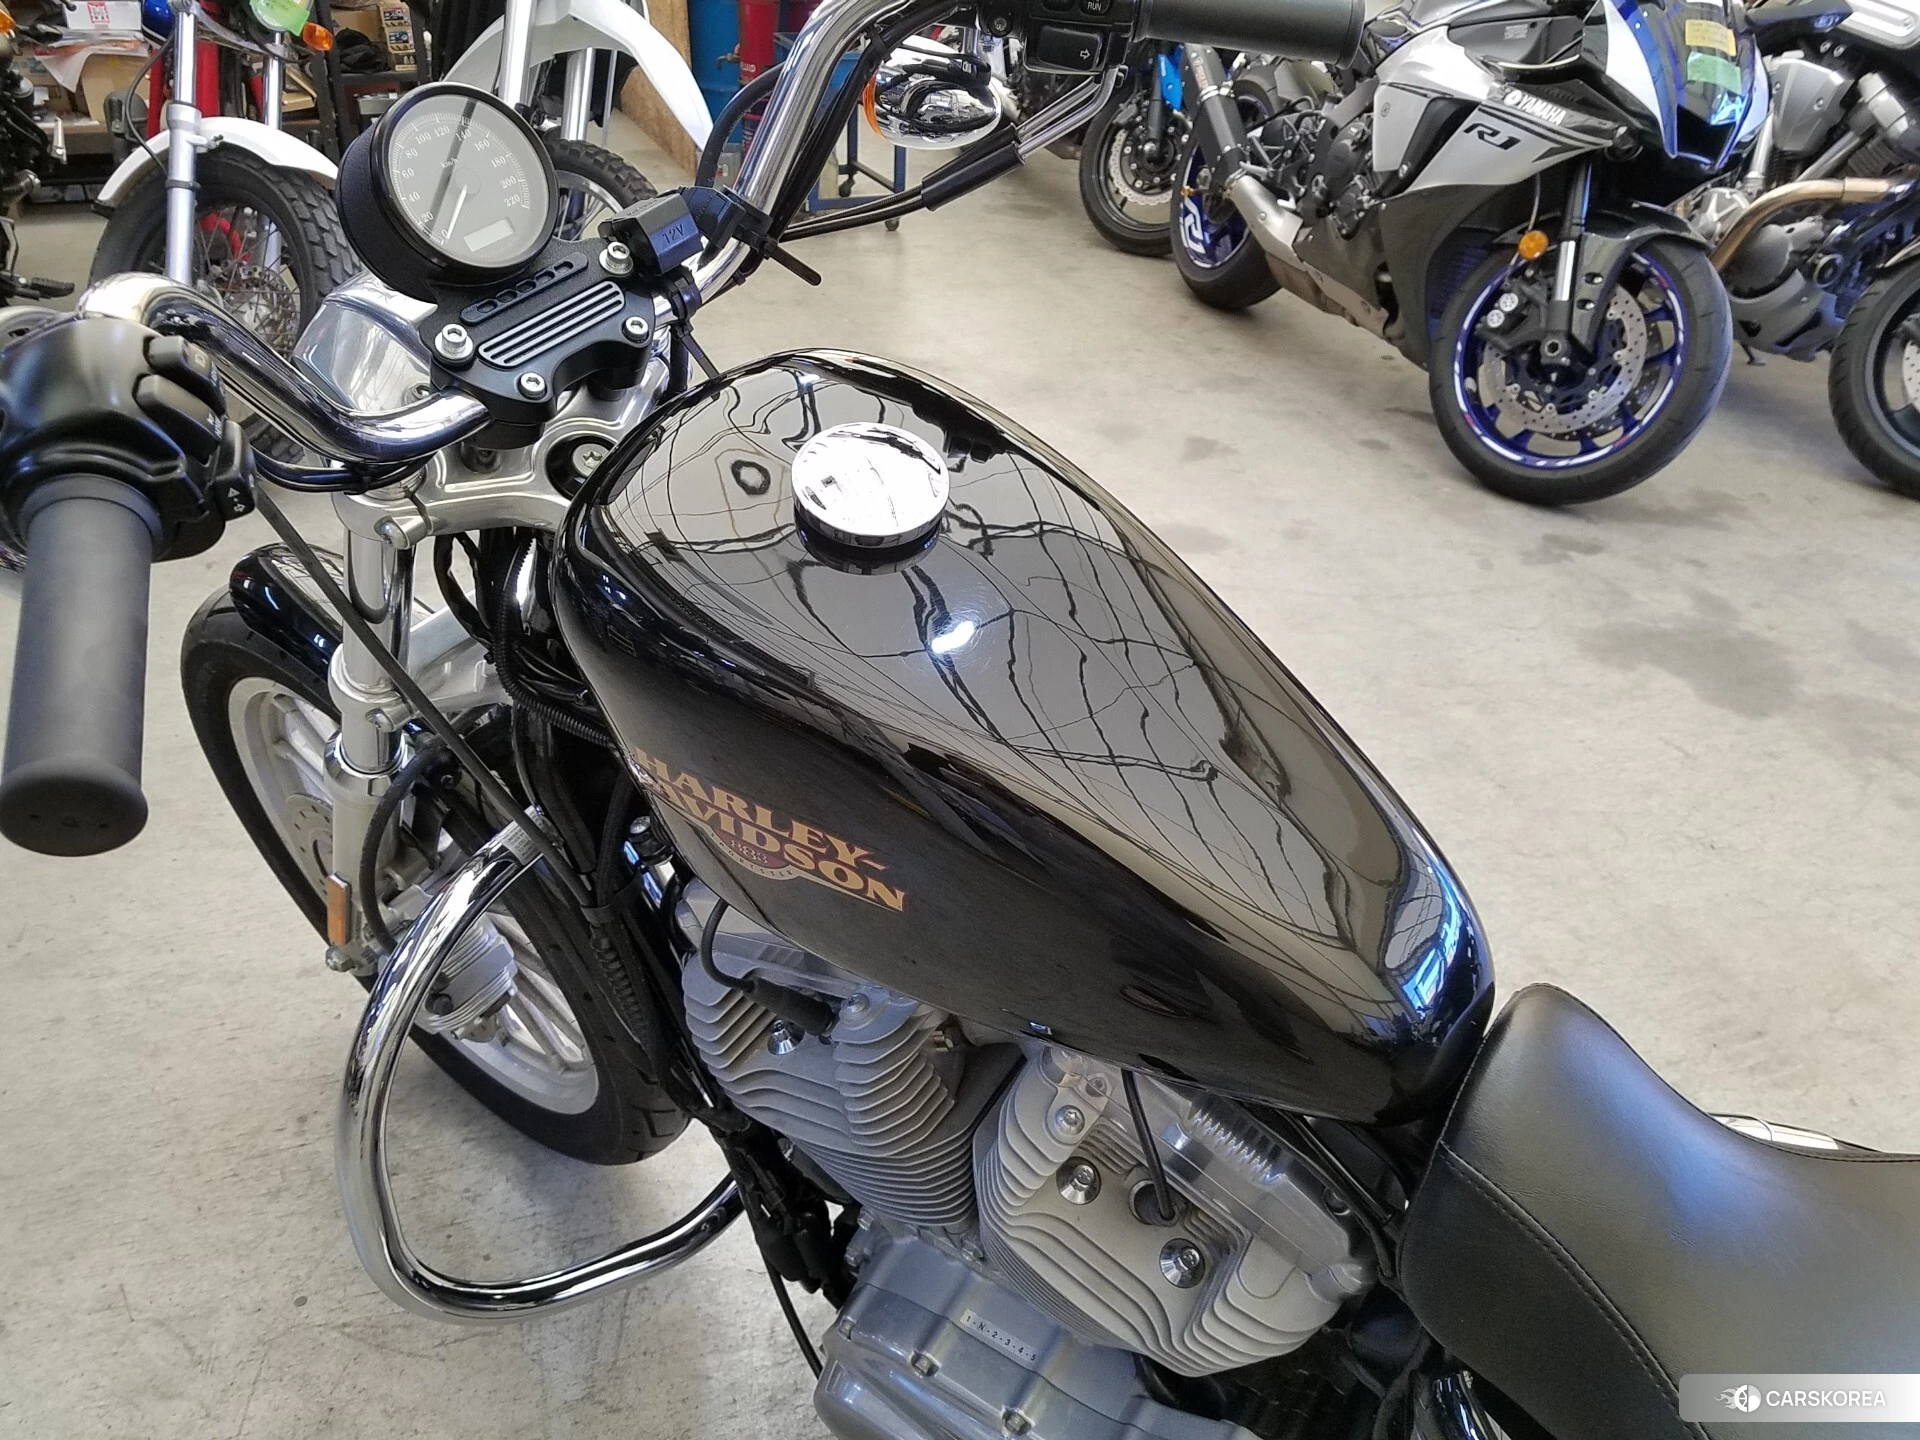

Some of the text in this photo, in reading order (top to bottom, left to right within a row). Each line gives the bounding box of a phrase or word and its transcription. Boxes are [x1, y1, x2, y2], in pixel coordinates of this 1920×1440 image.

[1087, 1, 1102, 12] RUN
[1517, 94, 1567, 126] YAMAHA
[433, 125, 450, 137] 120
[456, 129, 472, 141] 140
[415, 132, 431, 144] 100
[474, 139, 490, 152] 160
[405, 148, 418, 159] 80
[440, 157, 460, 169] km/h
[491, 156, 506, 168] 180
[401, 168, 415, 179] 60
[500, 175, 517, 189] 200
[408, 191, 420, 202] 40
[504, 194, 521, 207] 220
[421, 211, 434, 223] 20
[441, 229, 449, 238] 0
[662, 223, 685, 244] 12V
[635, 746, 888, 870] HARLEY-
[652, 779, 906, 911] AVIDSON
